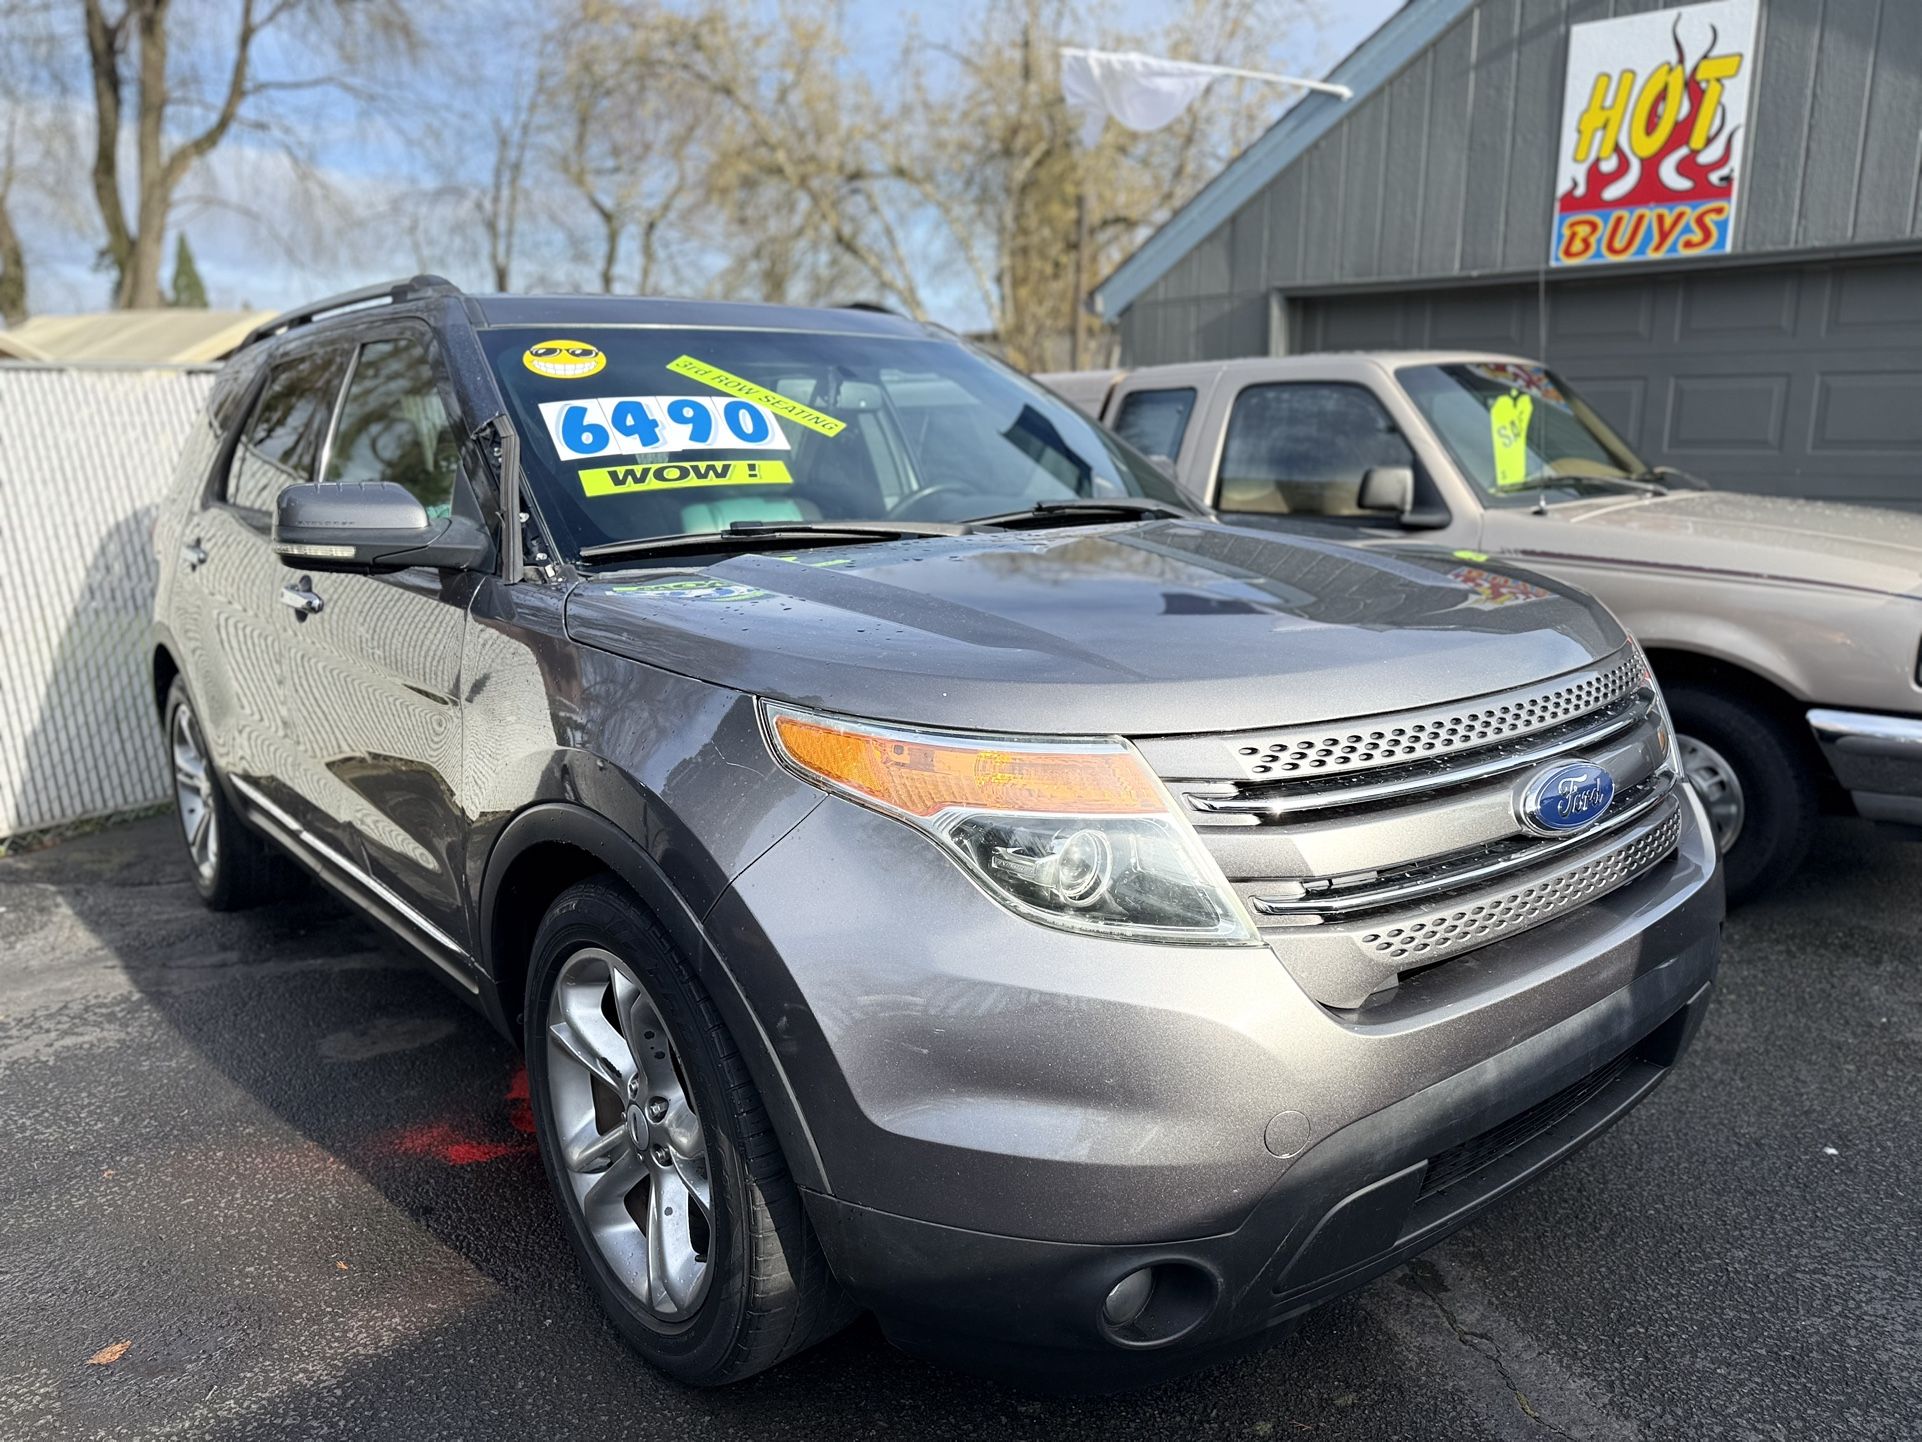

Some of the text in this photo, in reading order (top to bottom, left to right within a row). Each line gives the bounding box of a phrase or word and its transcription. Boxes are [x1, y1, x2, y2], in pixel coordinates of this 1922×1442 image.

[1573, 53, 1743, 163] HOT
[1559, 203, 1728, 262] BUYS
[676, 360, 839, 431] 3rd ROW SEATING
[561, 399, 770, 455] 6490
[607, 463, 732, 487] WOW
[1558, 774, 1604, 818] Ford
